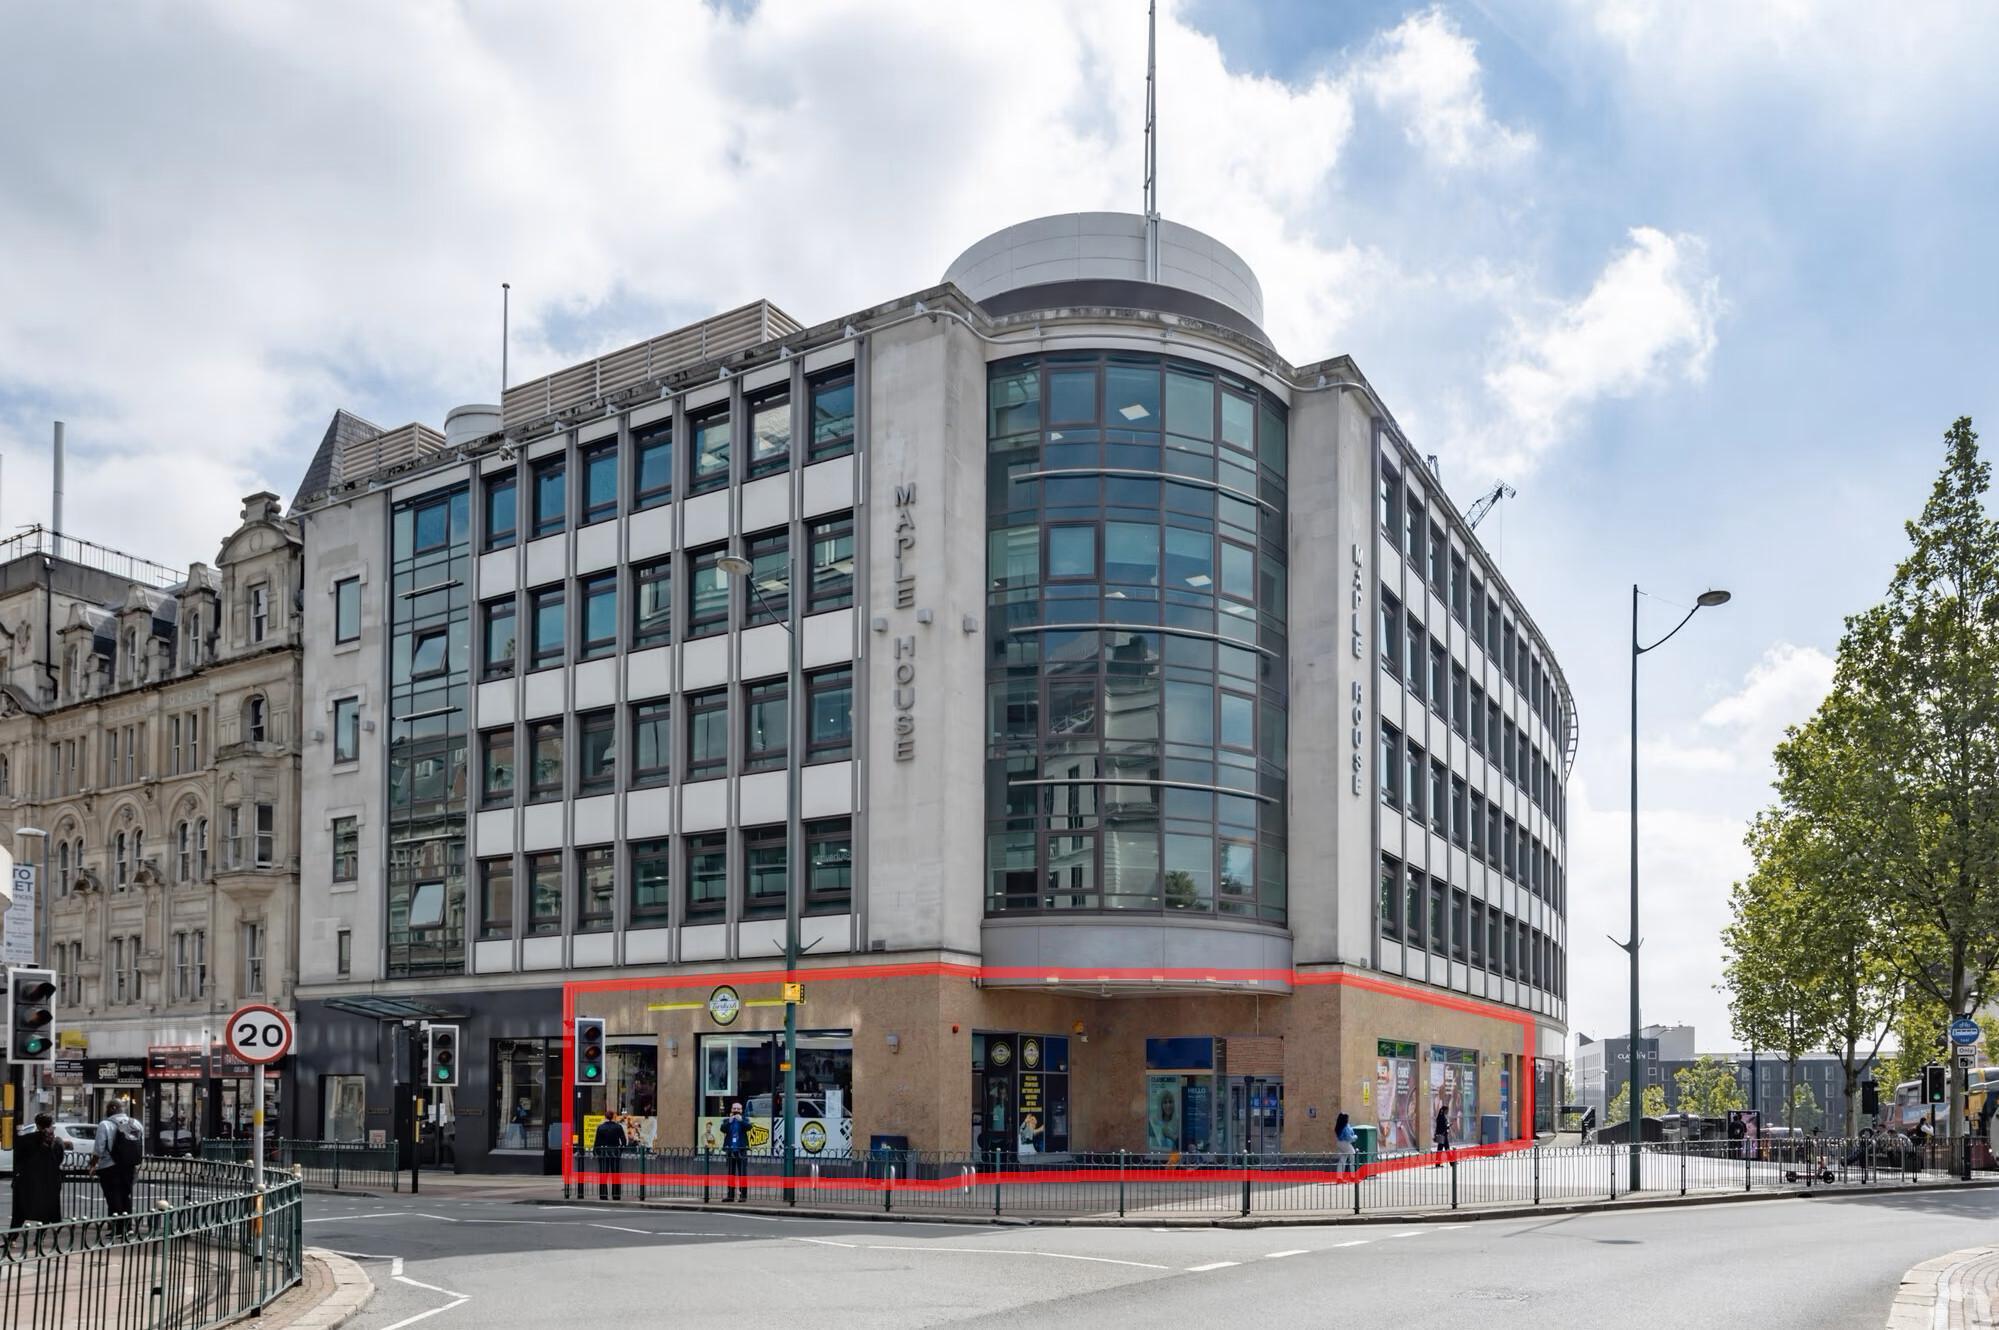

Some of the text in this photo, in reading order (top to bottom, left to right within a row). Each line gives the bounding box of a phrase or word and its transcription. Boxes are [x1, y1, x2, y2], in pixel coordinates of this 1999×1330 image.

[894, 482, 916, 762] MAPLE HOUSE
[1352, 543, 1363, 660] MAPLE
[13, 880, 34, 892] ET
[238, 1023, 283, 1047] 20
